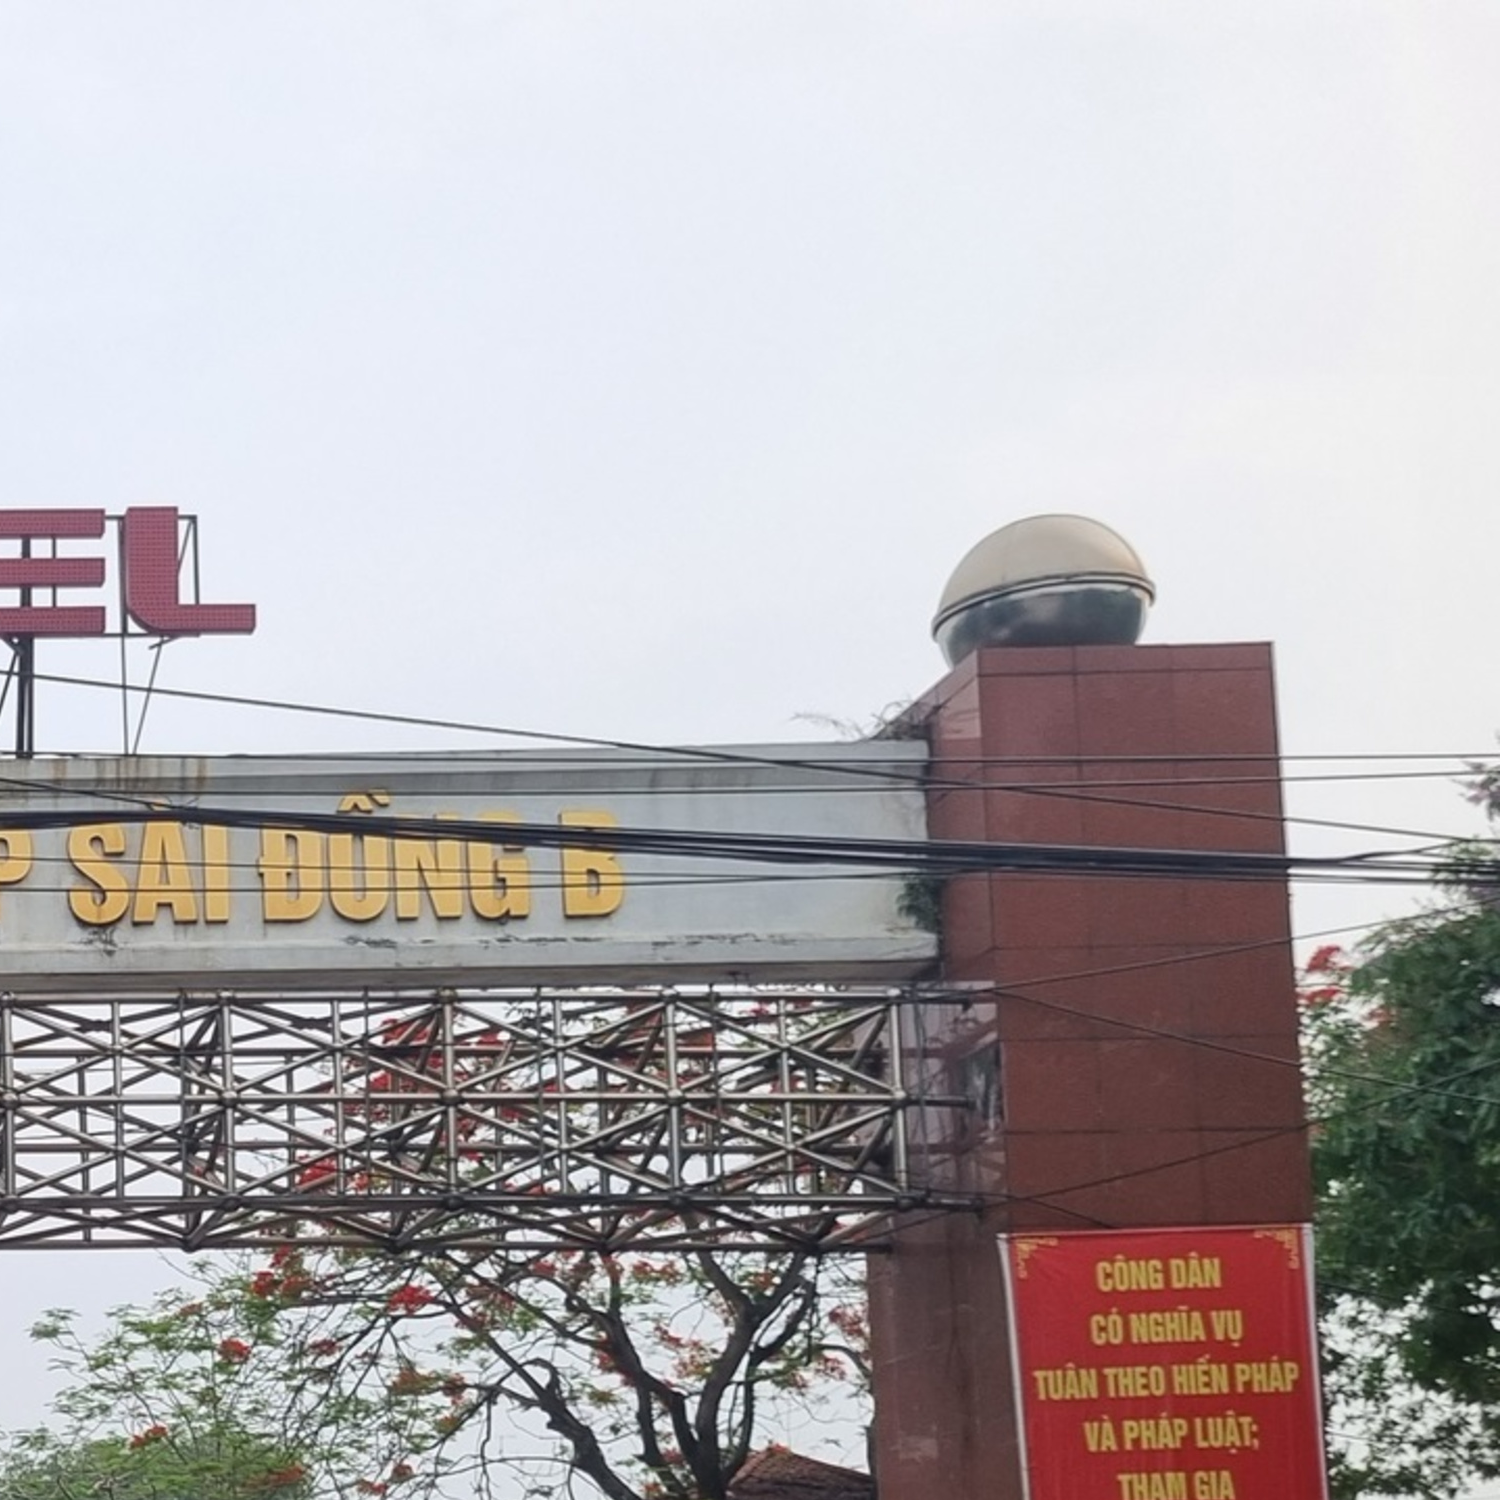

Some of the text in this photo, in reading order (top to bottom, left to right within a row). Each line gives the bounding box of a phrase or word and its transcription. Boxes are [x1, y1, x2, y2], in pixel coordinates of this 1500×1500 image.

[559, 811, 625, 918] B
[1096, 1251, 1221, 1292] CÔNG DÂN
[1090, 1306, 1242, 1347] CÓ NGHĨA VỤ
[1032, 1354, 1299, 1400] TUÂN THEO HIẾN PHÁP
[1083, 1410, 1259, 1454] VÀ PHÁP LUẬT;
